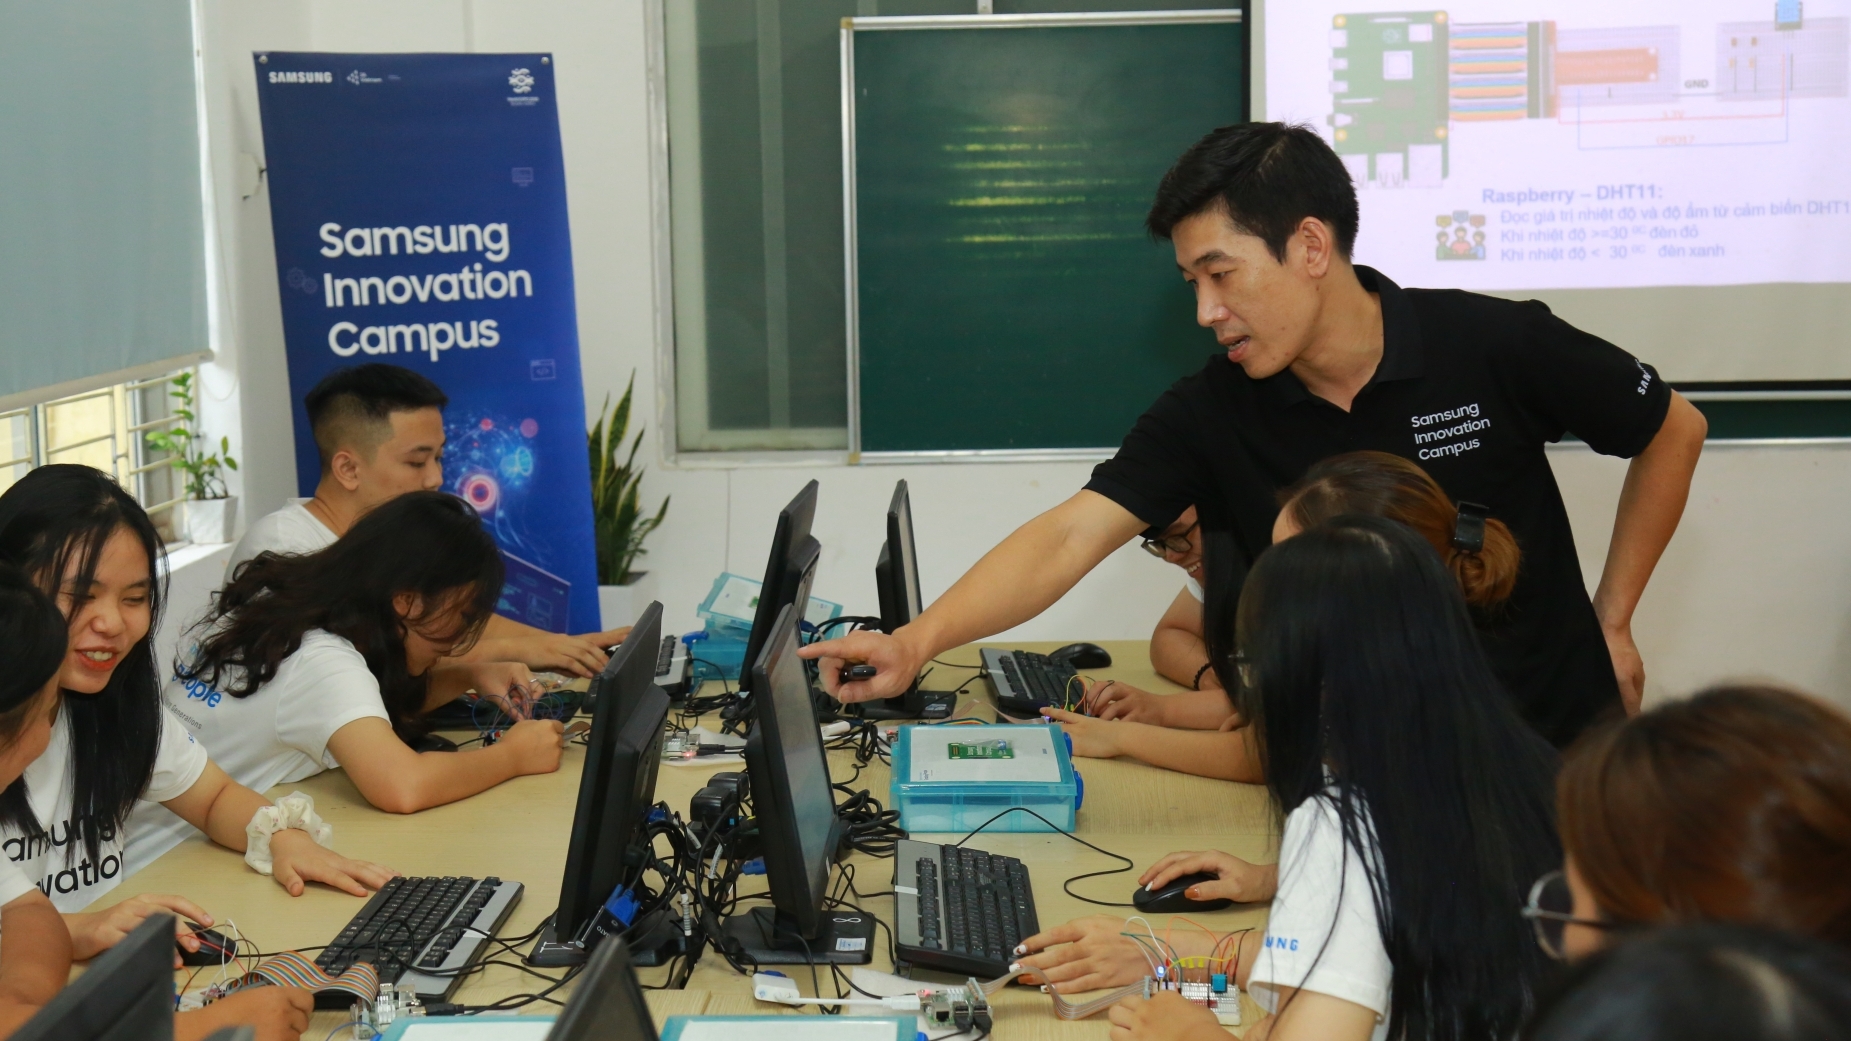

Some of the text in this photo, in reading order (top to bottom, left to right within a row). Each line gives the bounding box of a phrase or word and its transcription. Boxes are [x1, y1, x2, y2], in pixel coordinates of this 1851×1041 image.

[268, 71, 333, 83] SAMSUNG
[1684, 79, 1709, 89] GND
[1482, 187, 1574, 206] Raspberry
[1597, 184, 1663, 200] DHT11:
[1500, 209, 1530, 224] Đọc
[1578, 206, 1613, 222] nhiệt
[1617, 206, 1636, 222] độ
[1662, 205, 1681, 221] độ
[319, 222, 511, 262] Samsung
[1500, 229, 1524, 243] Khi
[1528, 228, 1563, 243] nhiệt
[1568, 227, 1586, 242] độ
[1500, 248, 1524, 262] Khi
[1528, 247, 1563, 261] nhiệt
[1568, 246, 1586, 261] độ
[1610, 245, 1628, 259] 30
[1689, 244, 1725, 257] xanh
[323, 262, 533, 307] Innovation
[328, 318, 500, 362] Campus
[1411, 403, 1480, 428] Samsung
[1414, 418, 1491, 445] Innovation
[1418, 438, 1481, 460] Campus
[170, 704, 203, 730] Generations
